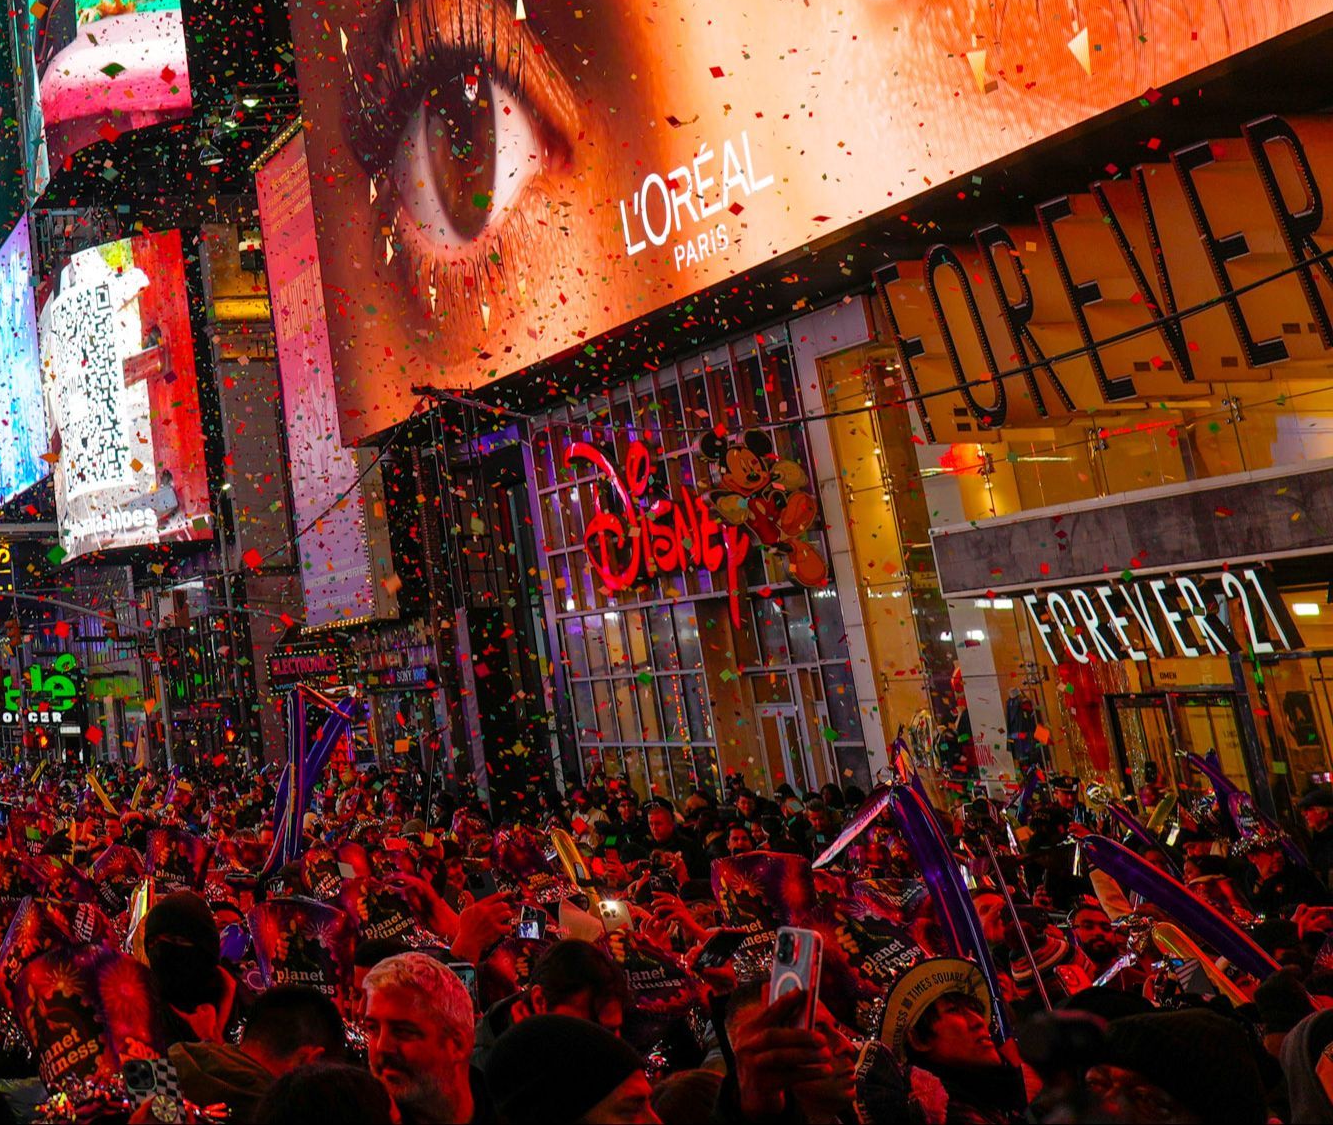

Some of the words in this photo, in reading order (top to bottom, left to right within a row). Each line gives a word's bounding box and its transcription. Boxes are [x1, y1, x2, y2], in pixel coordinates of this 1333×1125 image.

[620, 130, 775, 257] L'ORÉAL
[874, 113, 1333, 446] FOREVER
[1023, 577, 1236, 665] FOREVER
[1239, 569, 1295, 654] 21
[363, 910, 404, 941] planet
[861, 938, 906, 975] planet
[276, 969, 325, 983] planet
[908, 975, 933, 1002] TIMES
